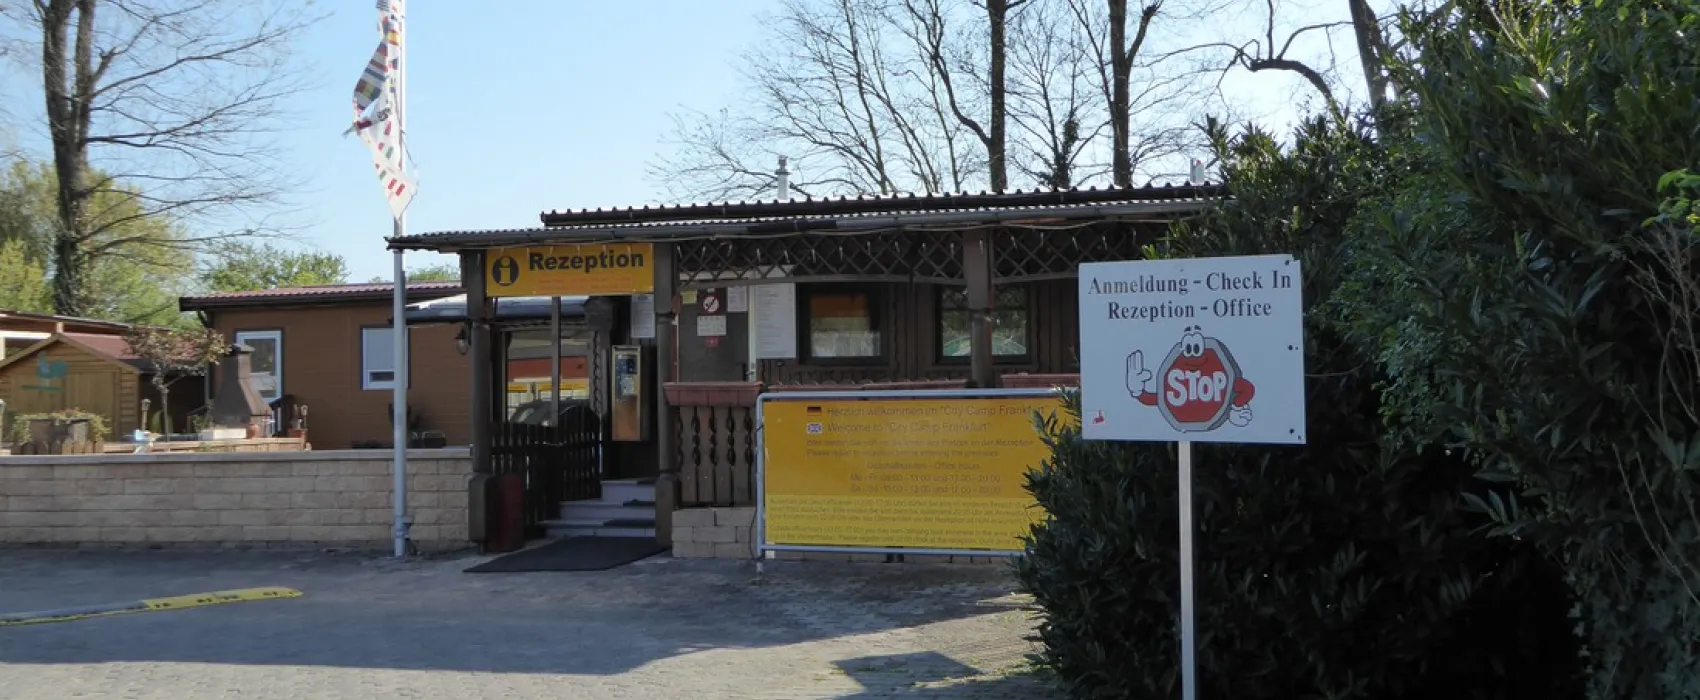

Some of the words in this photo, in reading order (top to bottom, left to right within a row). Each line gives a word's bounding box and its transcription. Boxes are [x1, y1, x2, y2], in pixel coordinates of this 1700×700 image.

[529, 249, 643, 273] Rezeption
[1088, 275, 1188, 295] Anmeldung
[1206, 271, 1263, 291] Check
[1272, 270, 1291, 289] In
[1108, 300, 1195, 322] Rezeption
[1212, 298, 1272, 318] Office
[1166, 368, 1227, 407] STOP
